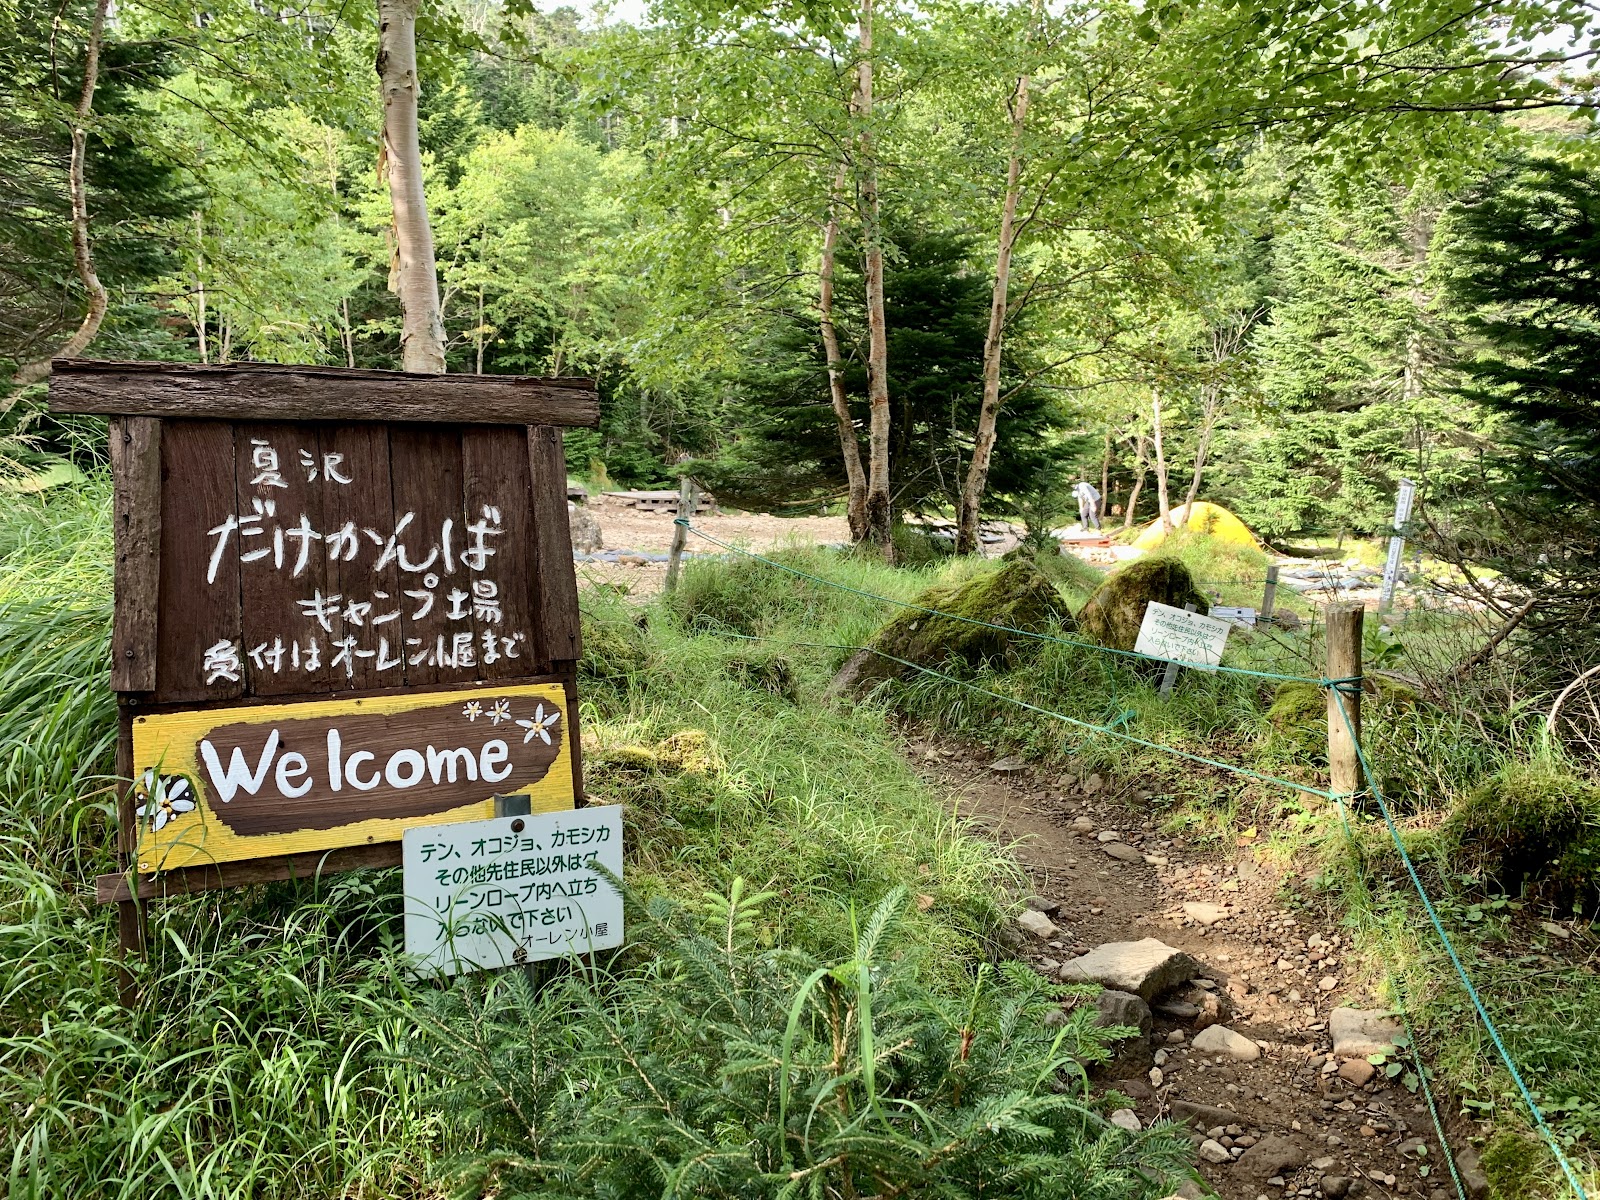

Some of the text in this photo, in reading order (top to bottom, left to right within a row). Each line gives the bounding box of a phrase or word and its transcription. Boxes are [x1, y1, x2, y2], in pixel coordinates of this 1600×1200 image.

[250, 438, 353, 488] 夏沢
[206, 497, 504, 585] だけかんば
[296, 573, 502, 633] キャンプ場
[203, 629, 526, 686] 受付はオーレン小屋まで
[200, 728, 513, 803] Welcome
[420, 825, 611, 862] テン、オコジョ、カモシカ
[435, 877, 598, 914] リーンロープ内へ立ち
[521, 922, 609, 948] オーレン小屋
